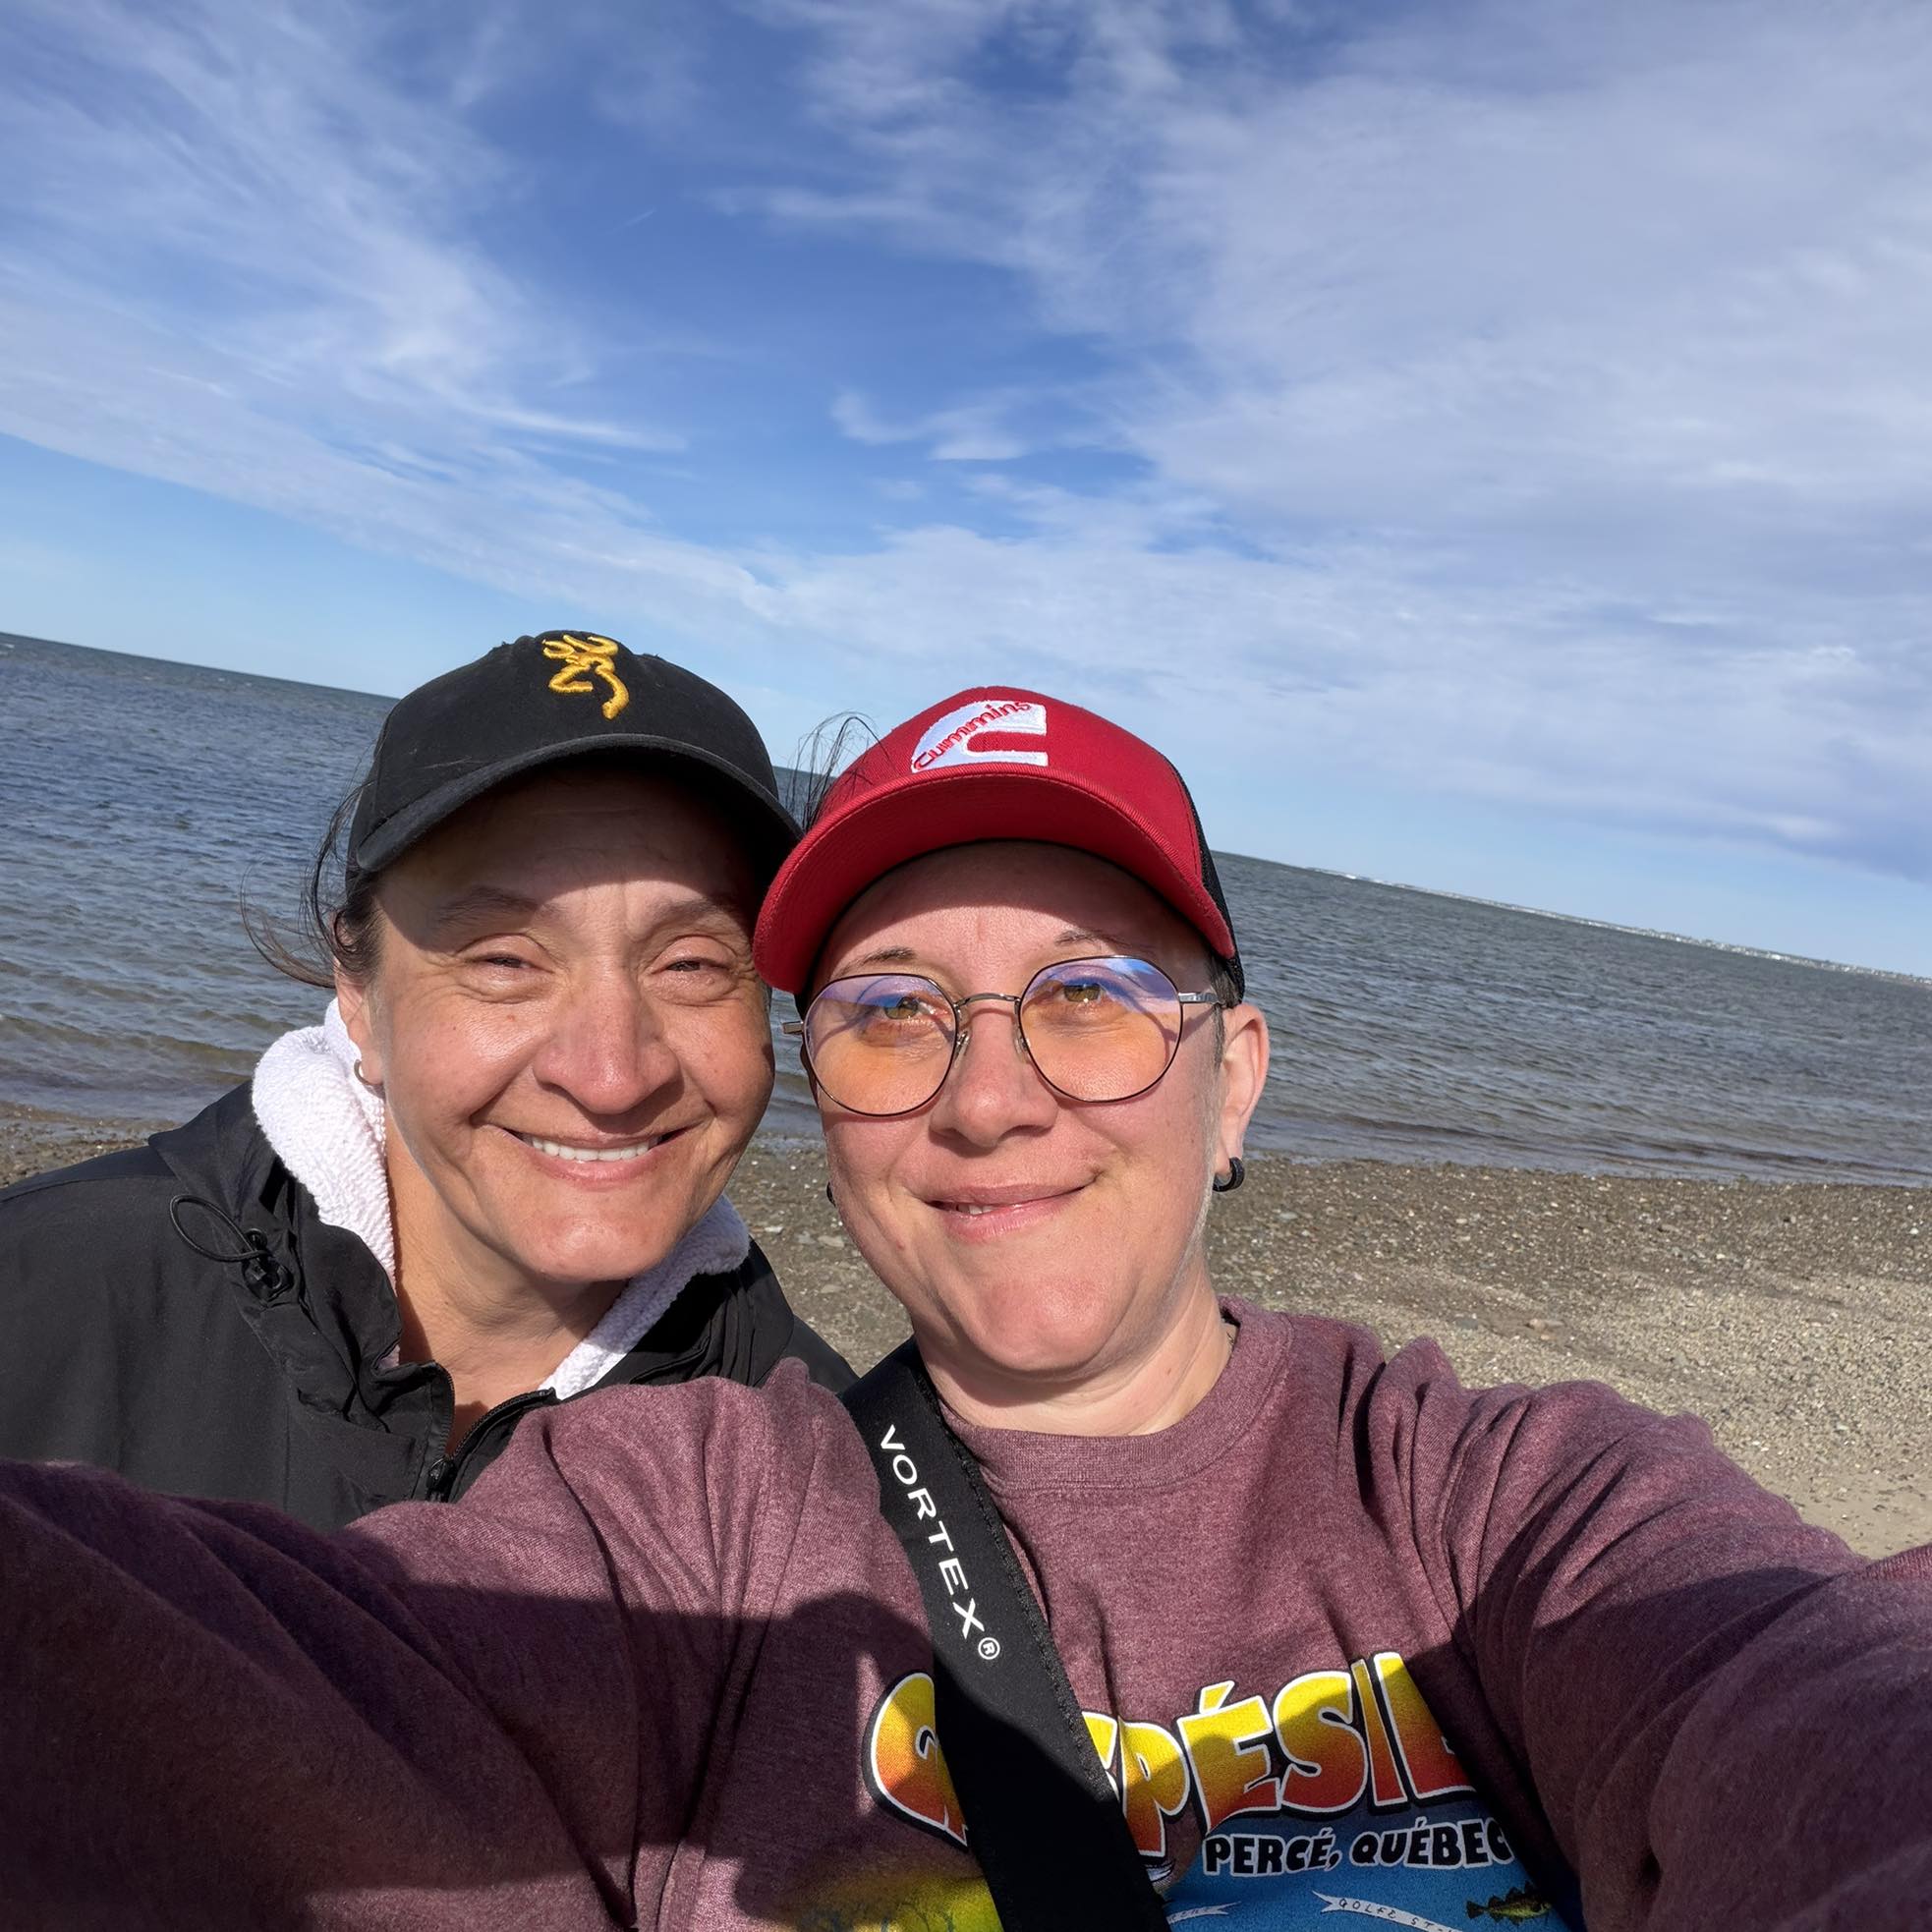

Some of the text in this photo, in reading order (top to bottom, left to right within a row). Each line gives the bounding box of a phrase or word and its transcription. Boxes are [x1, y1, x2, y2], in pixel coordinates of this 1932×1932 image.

[913, 701, 1032, 770] Cummins
[1202, 1817, 1515, 1876] PERCÉ, QUÉBEC
